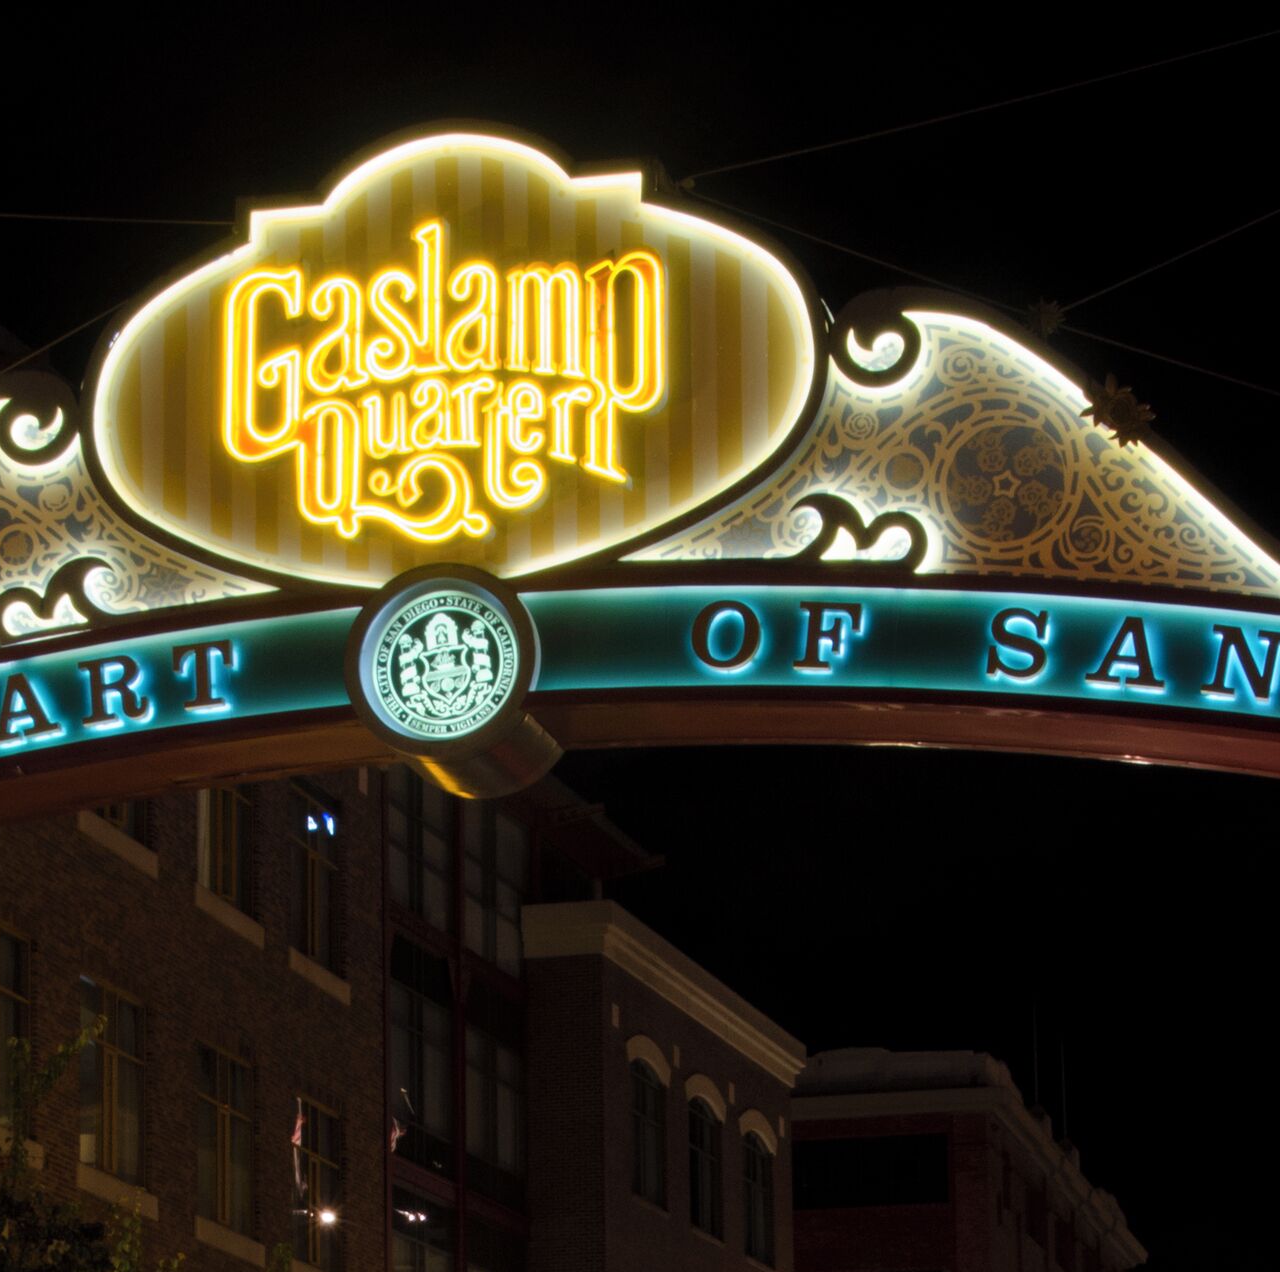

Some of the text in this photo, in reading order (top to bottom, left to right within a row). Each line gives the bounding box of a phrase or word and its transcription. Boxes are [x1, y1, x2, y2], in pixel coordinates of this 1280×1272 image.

[222, 218, 666, 482] Gaslamp
[297, 374, 598, 543] Quarter
[376, 597, 514, 719] THE CITY OF SAN DIEGO STATE OF CALIFORNIA
[690, 600, 863, 673] OF
[410, 707, 493, 733] SEMPER VIGILANS
